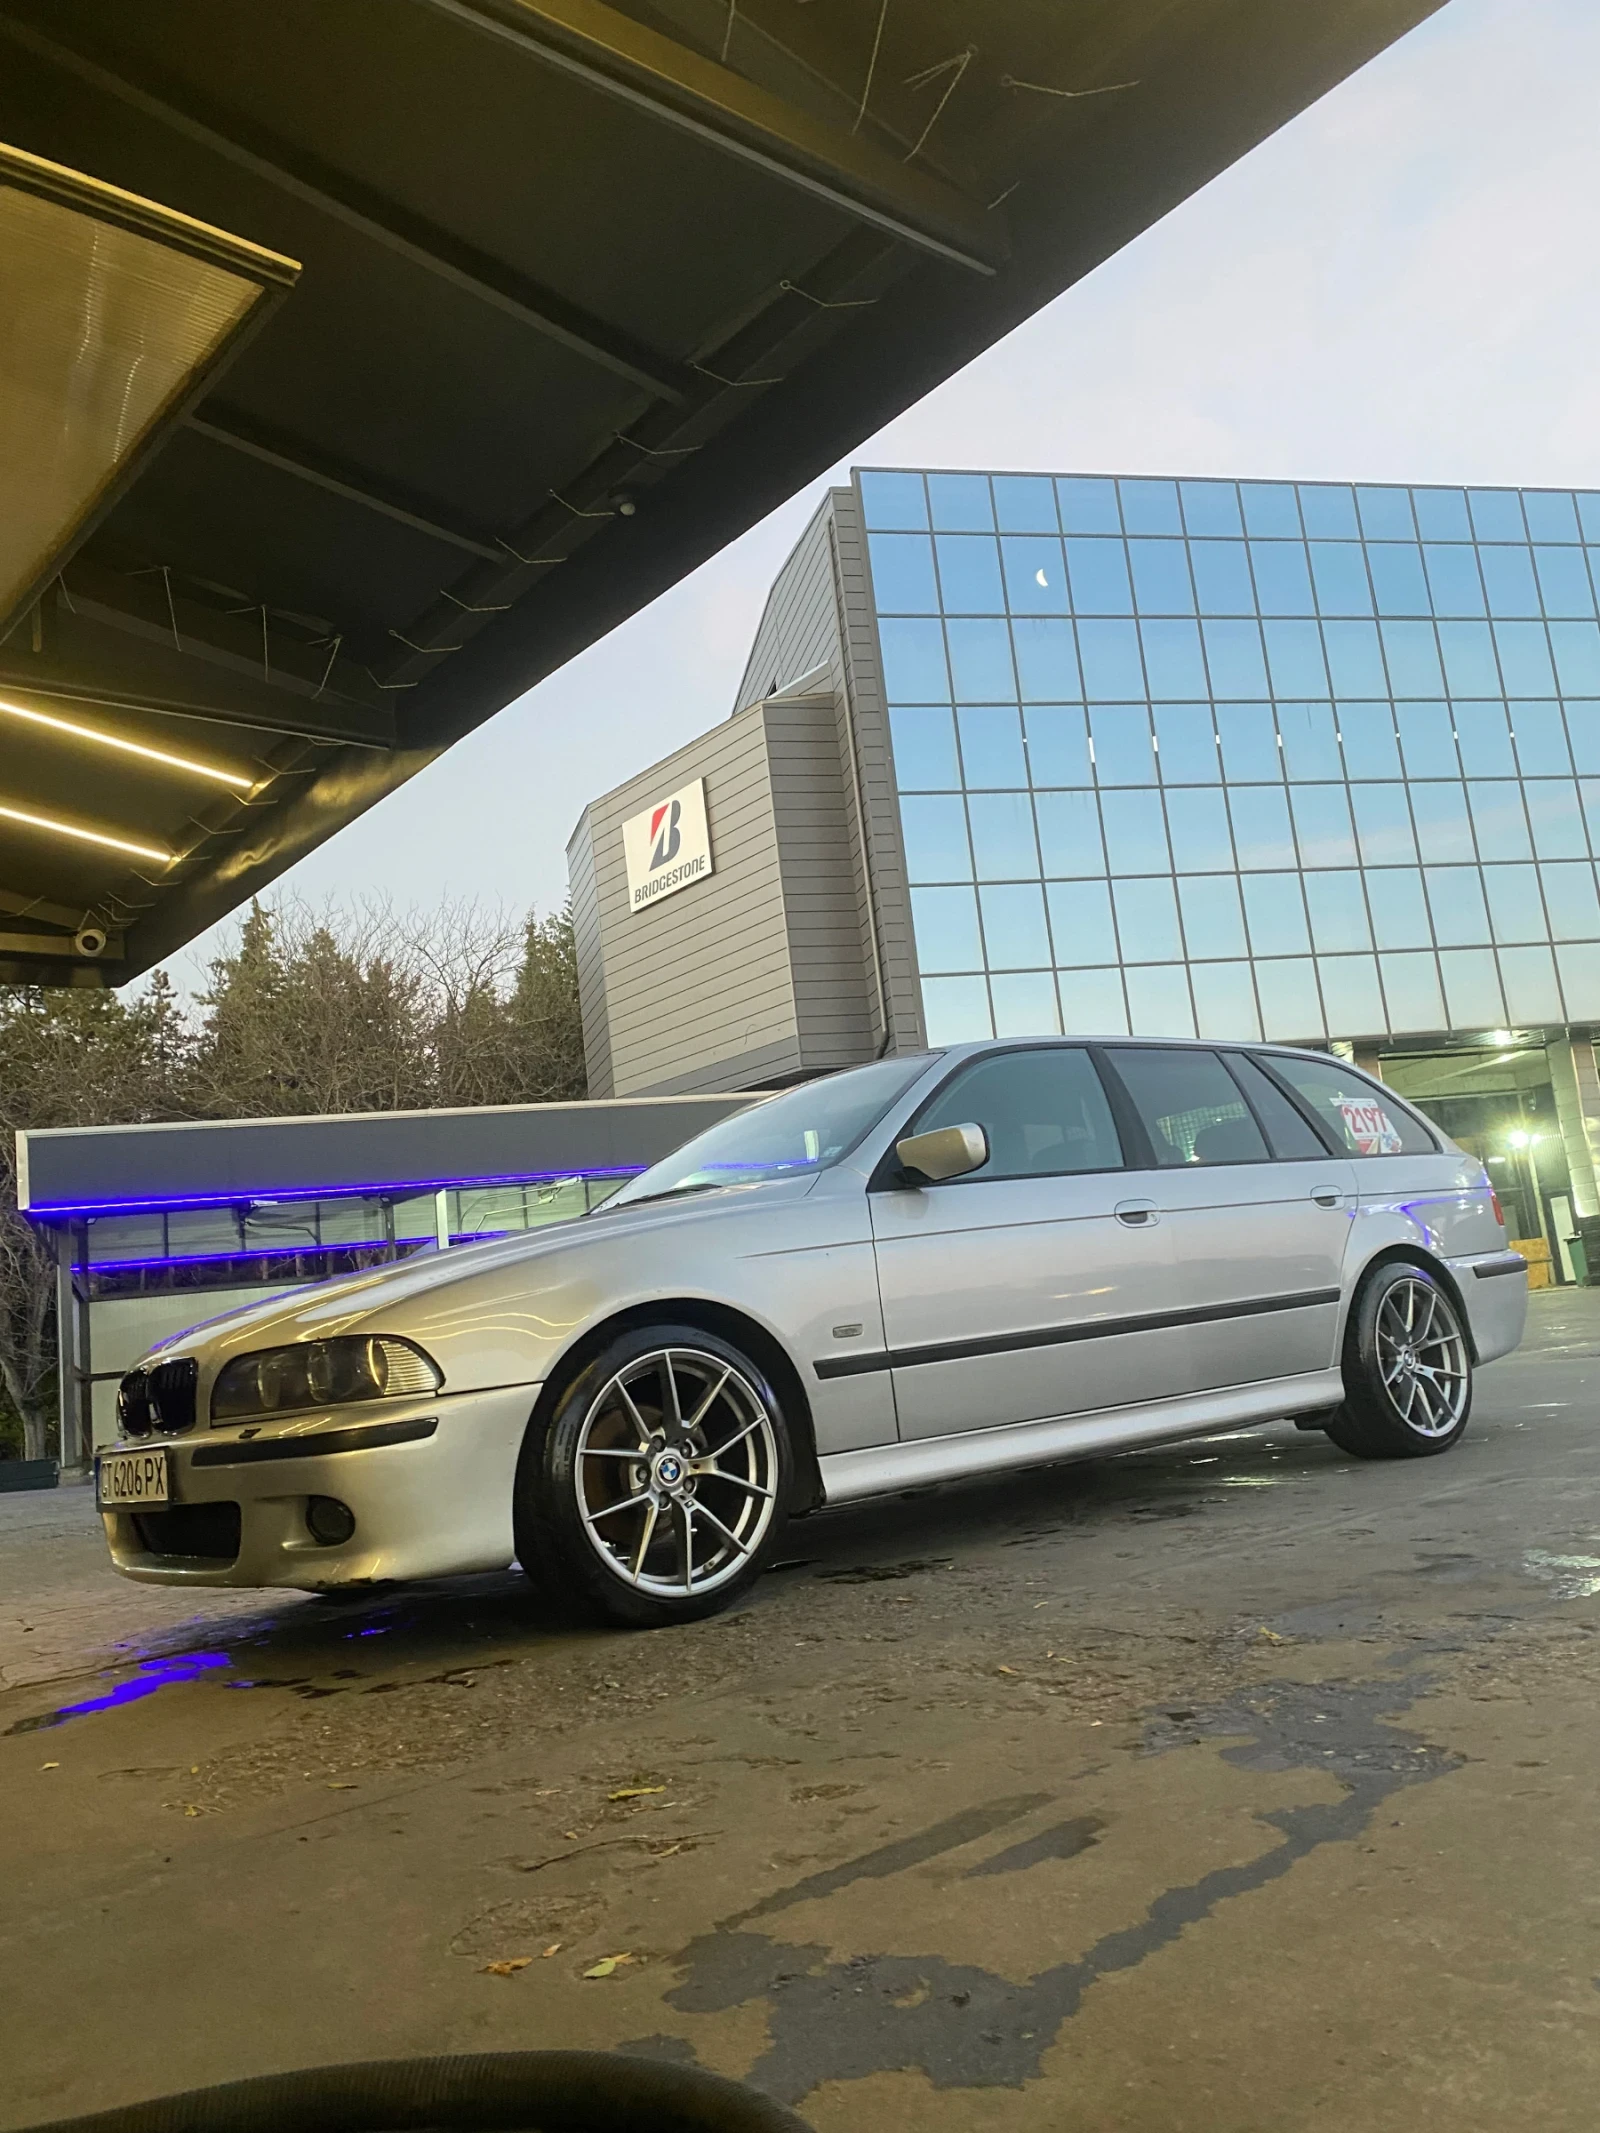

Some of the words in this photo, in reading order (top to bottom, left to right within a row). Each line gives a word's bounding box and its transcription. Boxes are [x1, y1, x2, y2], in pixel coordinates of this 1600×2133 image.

[633, 854, 706, 904] BRIDGESTONE
[113, 1459, 143, 1497] 6206
[144, 1456, 165, 1495] PX
